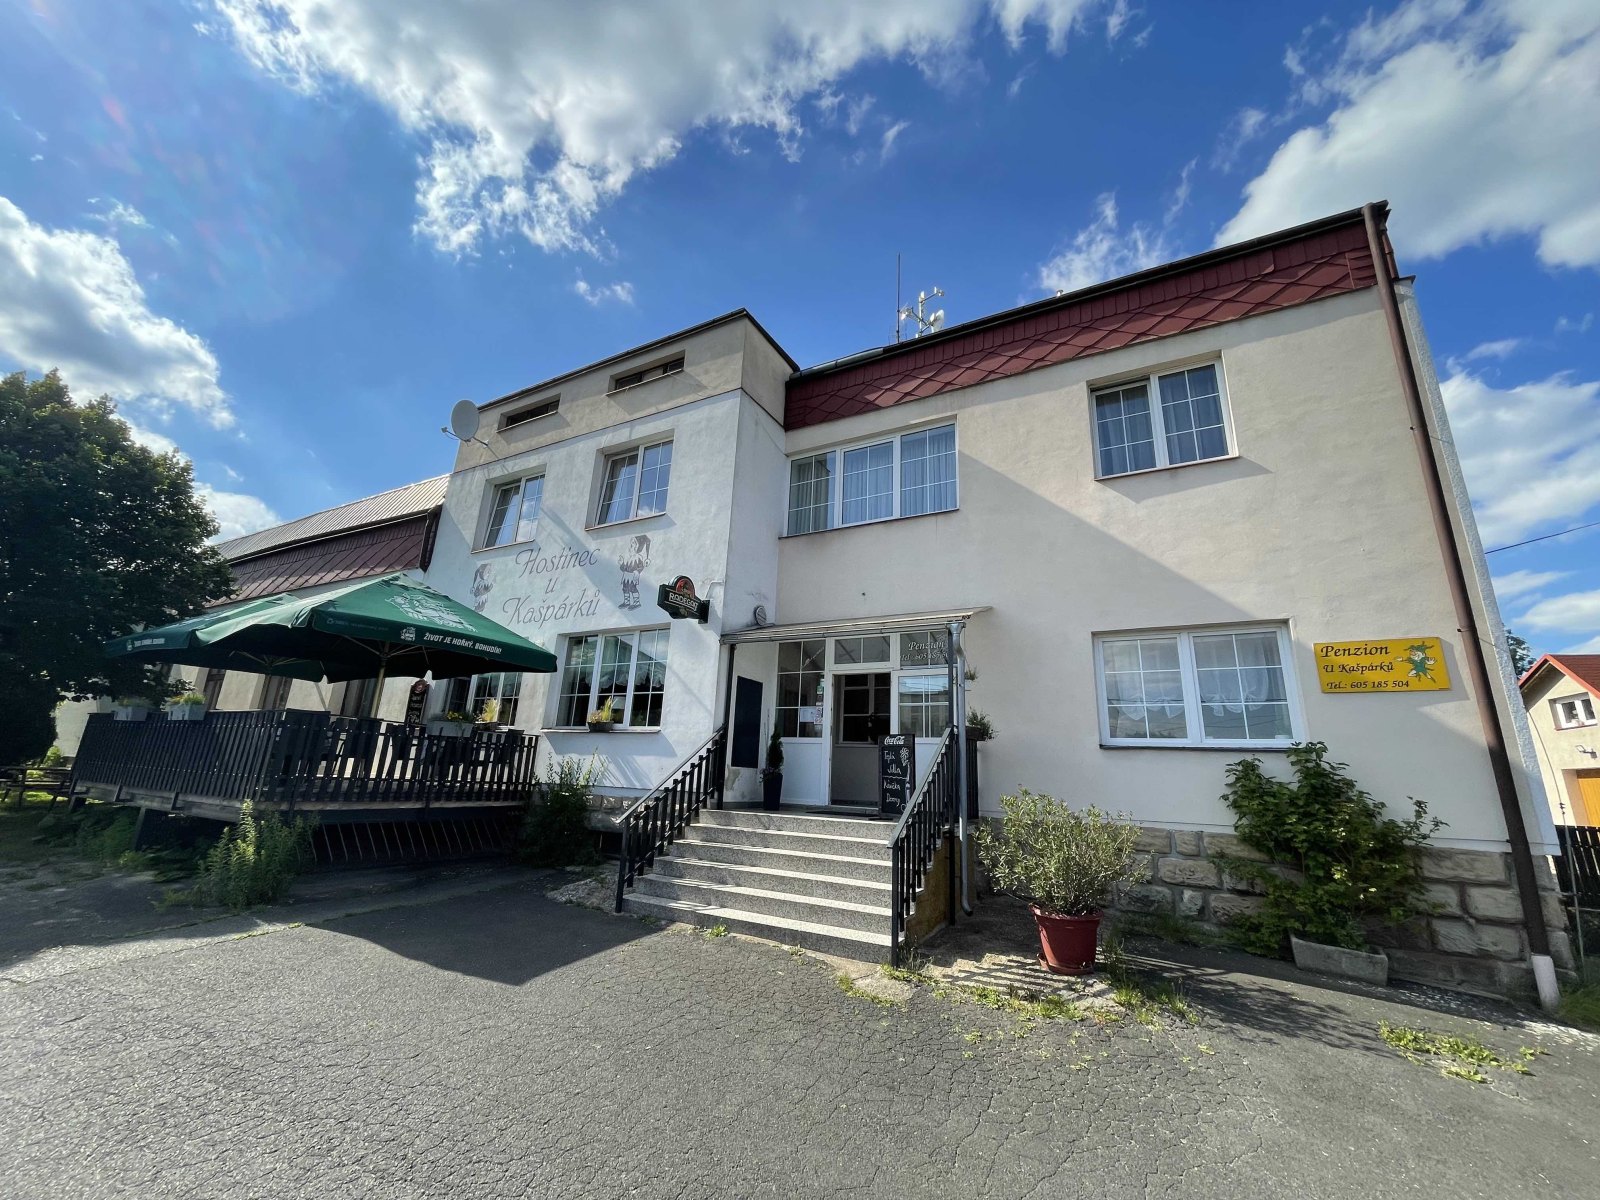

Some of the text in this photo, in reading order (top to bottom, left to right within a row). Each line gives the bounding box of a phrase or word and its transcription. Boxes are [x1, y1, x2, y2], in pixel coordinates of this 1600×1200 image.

[515, 546, 600, 578] Hostinec
[545, 577, 558, 594] u
[502, 588, 600, 629] Kašpárků
[423, 632, 443, 643] ŽIVOT
[443, 636, 451, 644] JE
[1320, 643, 1390, 657] Penzion
[1323, 661, 1394, 674] U Kašpárků
[1350, 681, 1368, 689] 605
[1371, 680, 1389, 688] 185
[1391, 680, 1410, 688] 504
